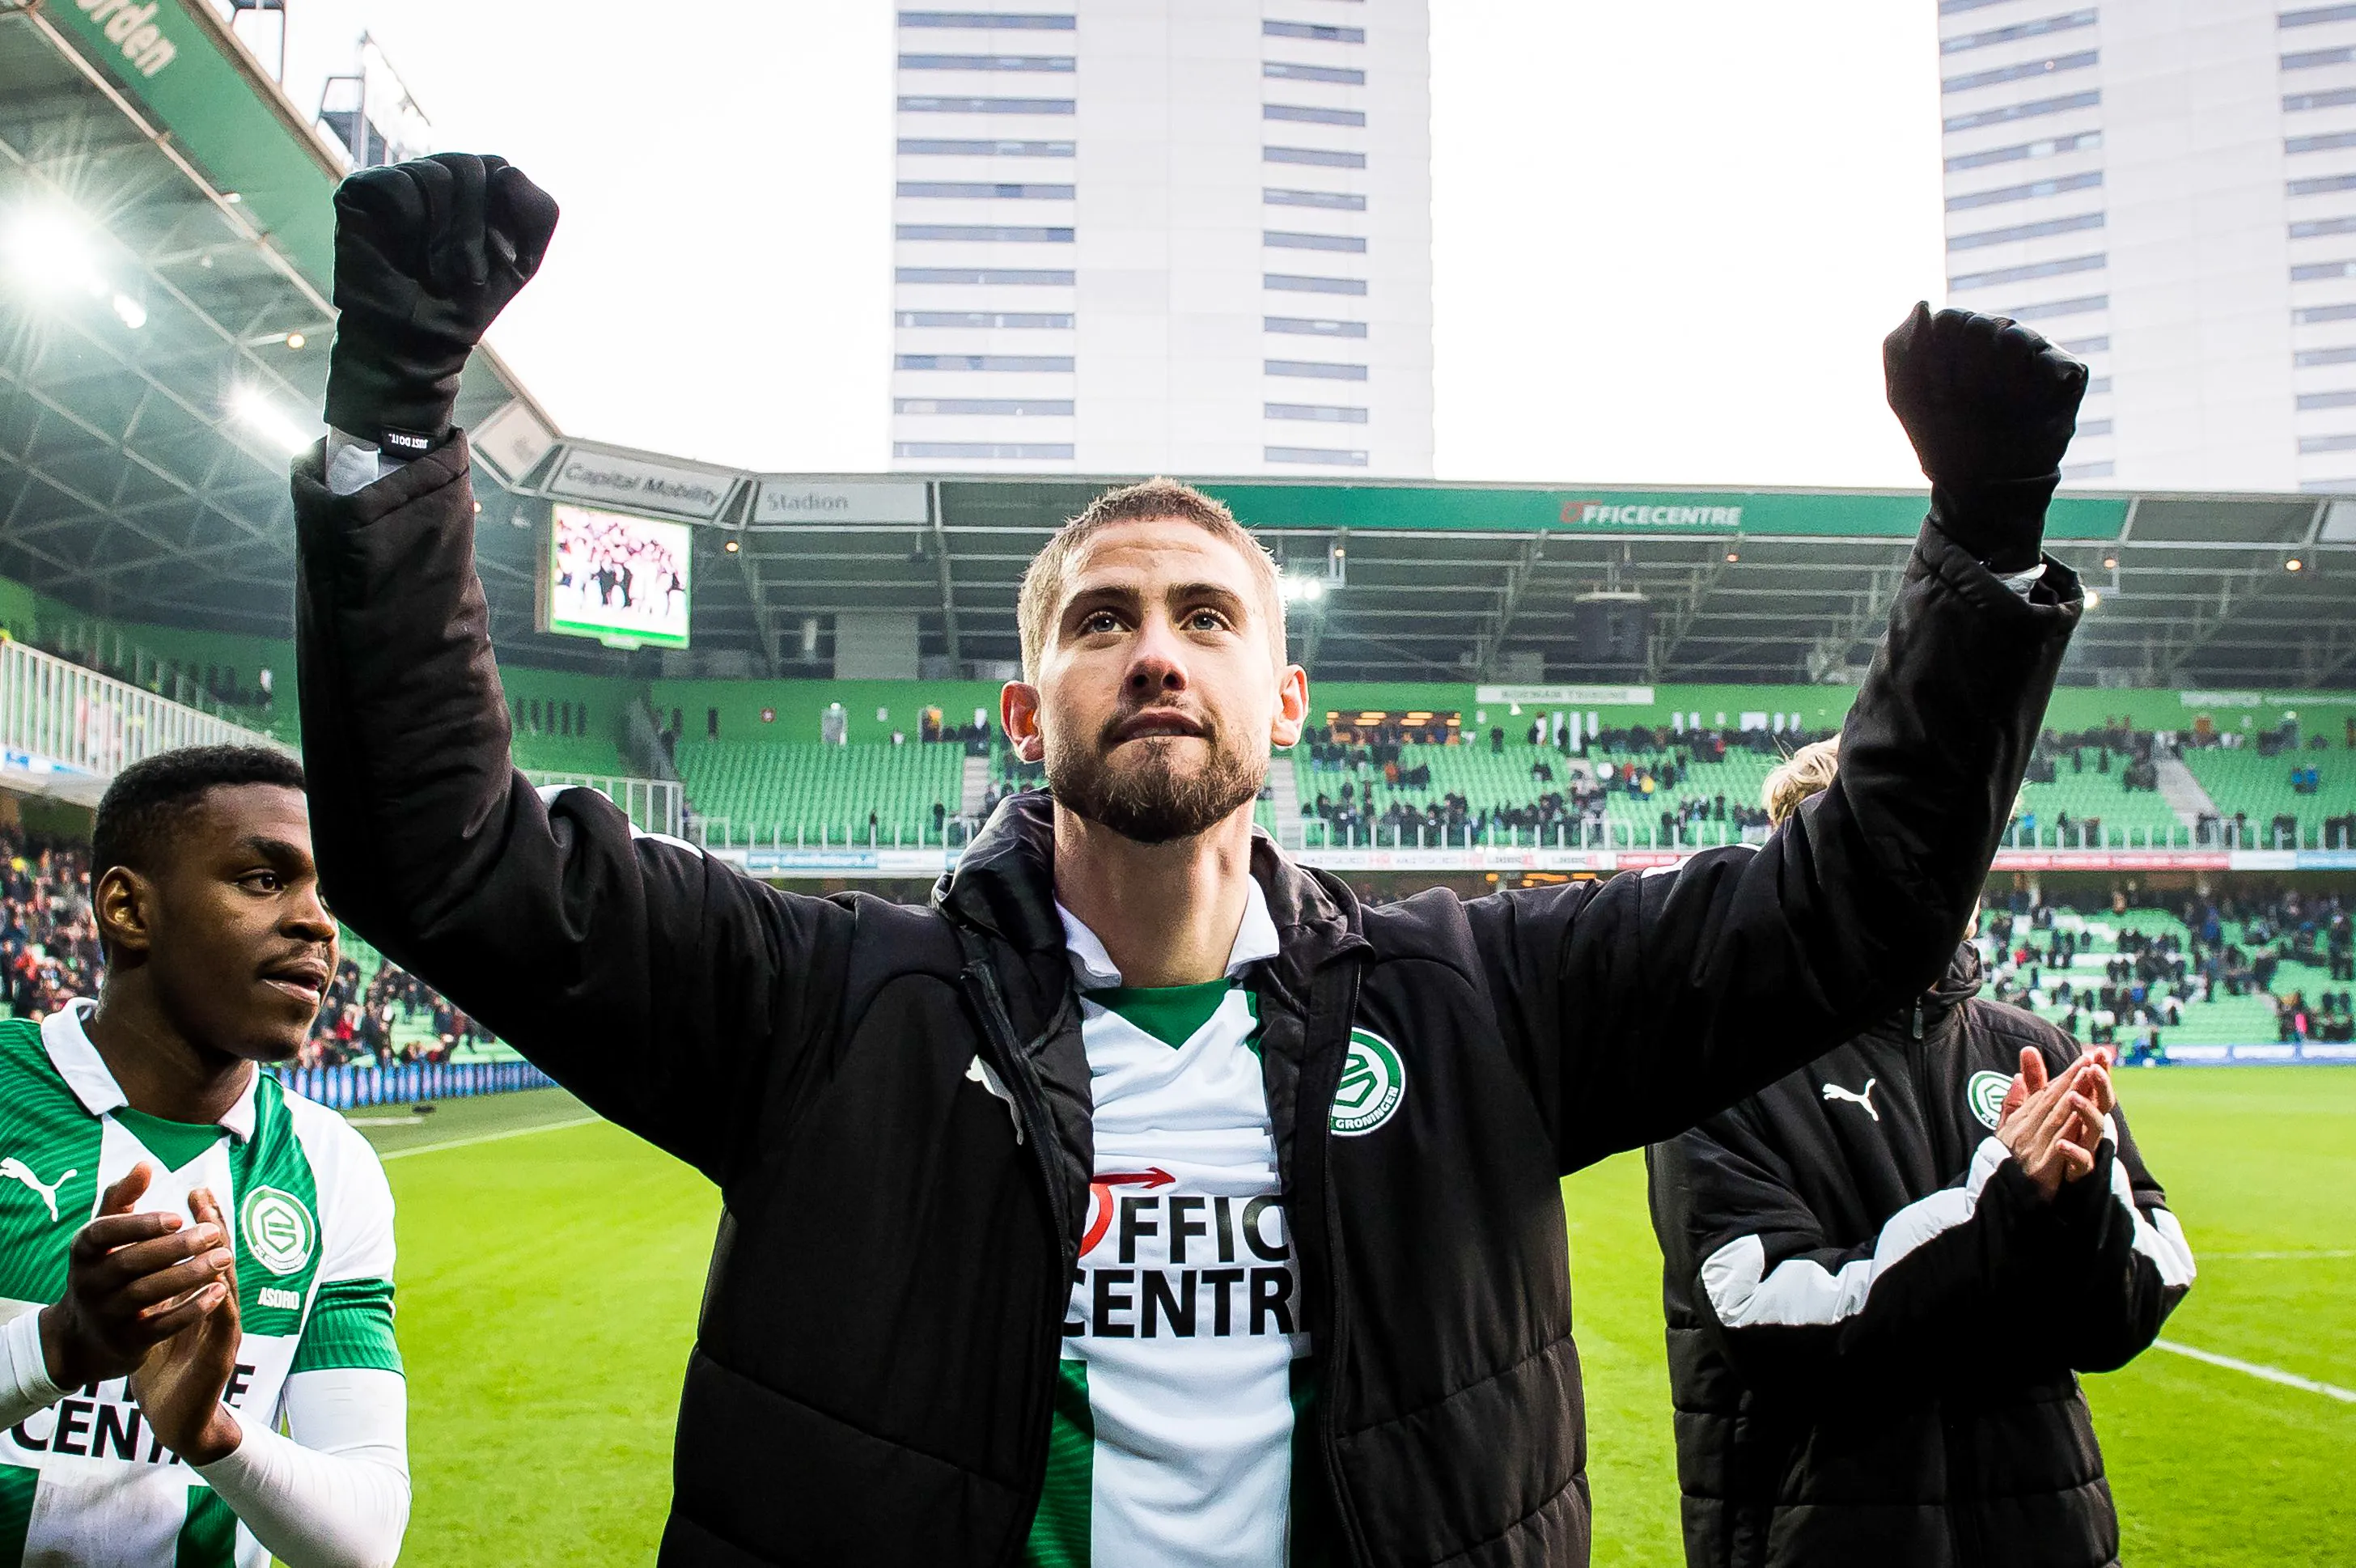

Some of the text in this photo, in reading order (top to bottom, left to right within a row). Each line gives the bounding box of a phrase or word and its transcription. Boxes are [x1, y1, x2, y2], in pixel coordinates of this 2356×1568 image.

[74, 0, 176, 78] rden
[400, 436, 410, 447] DO
[411, 436, 429, 449] JUST
[566, 462, 719, 506] Capital Mobility
[767, 490, 850, 511] Stadion
[1560, 501, 1742, 526] OFFICECENTRE
[1335, 1085, 1400, 1129] GRONINGEN
[257, 1286, 300, 1311] ASORO
[11, 1398, 181, 1465] CEN
